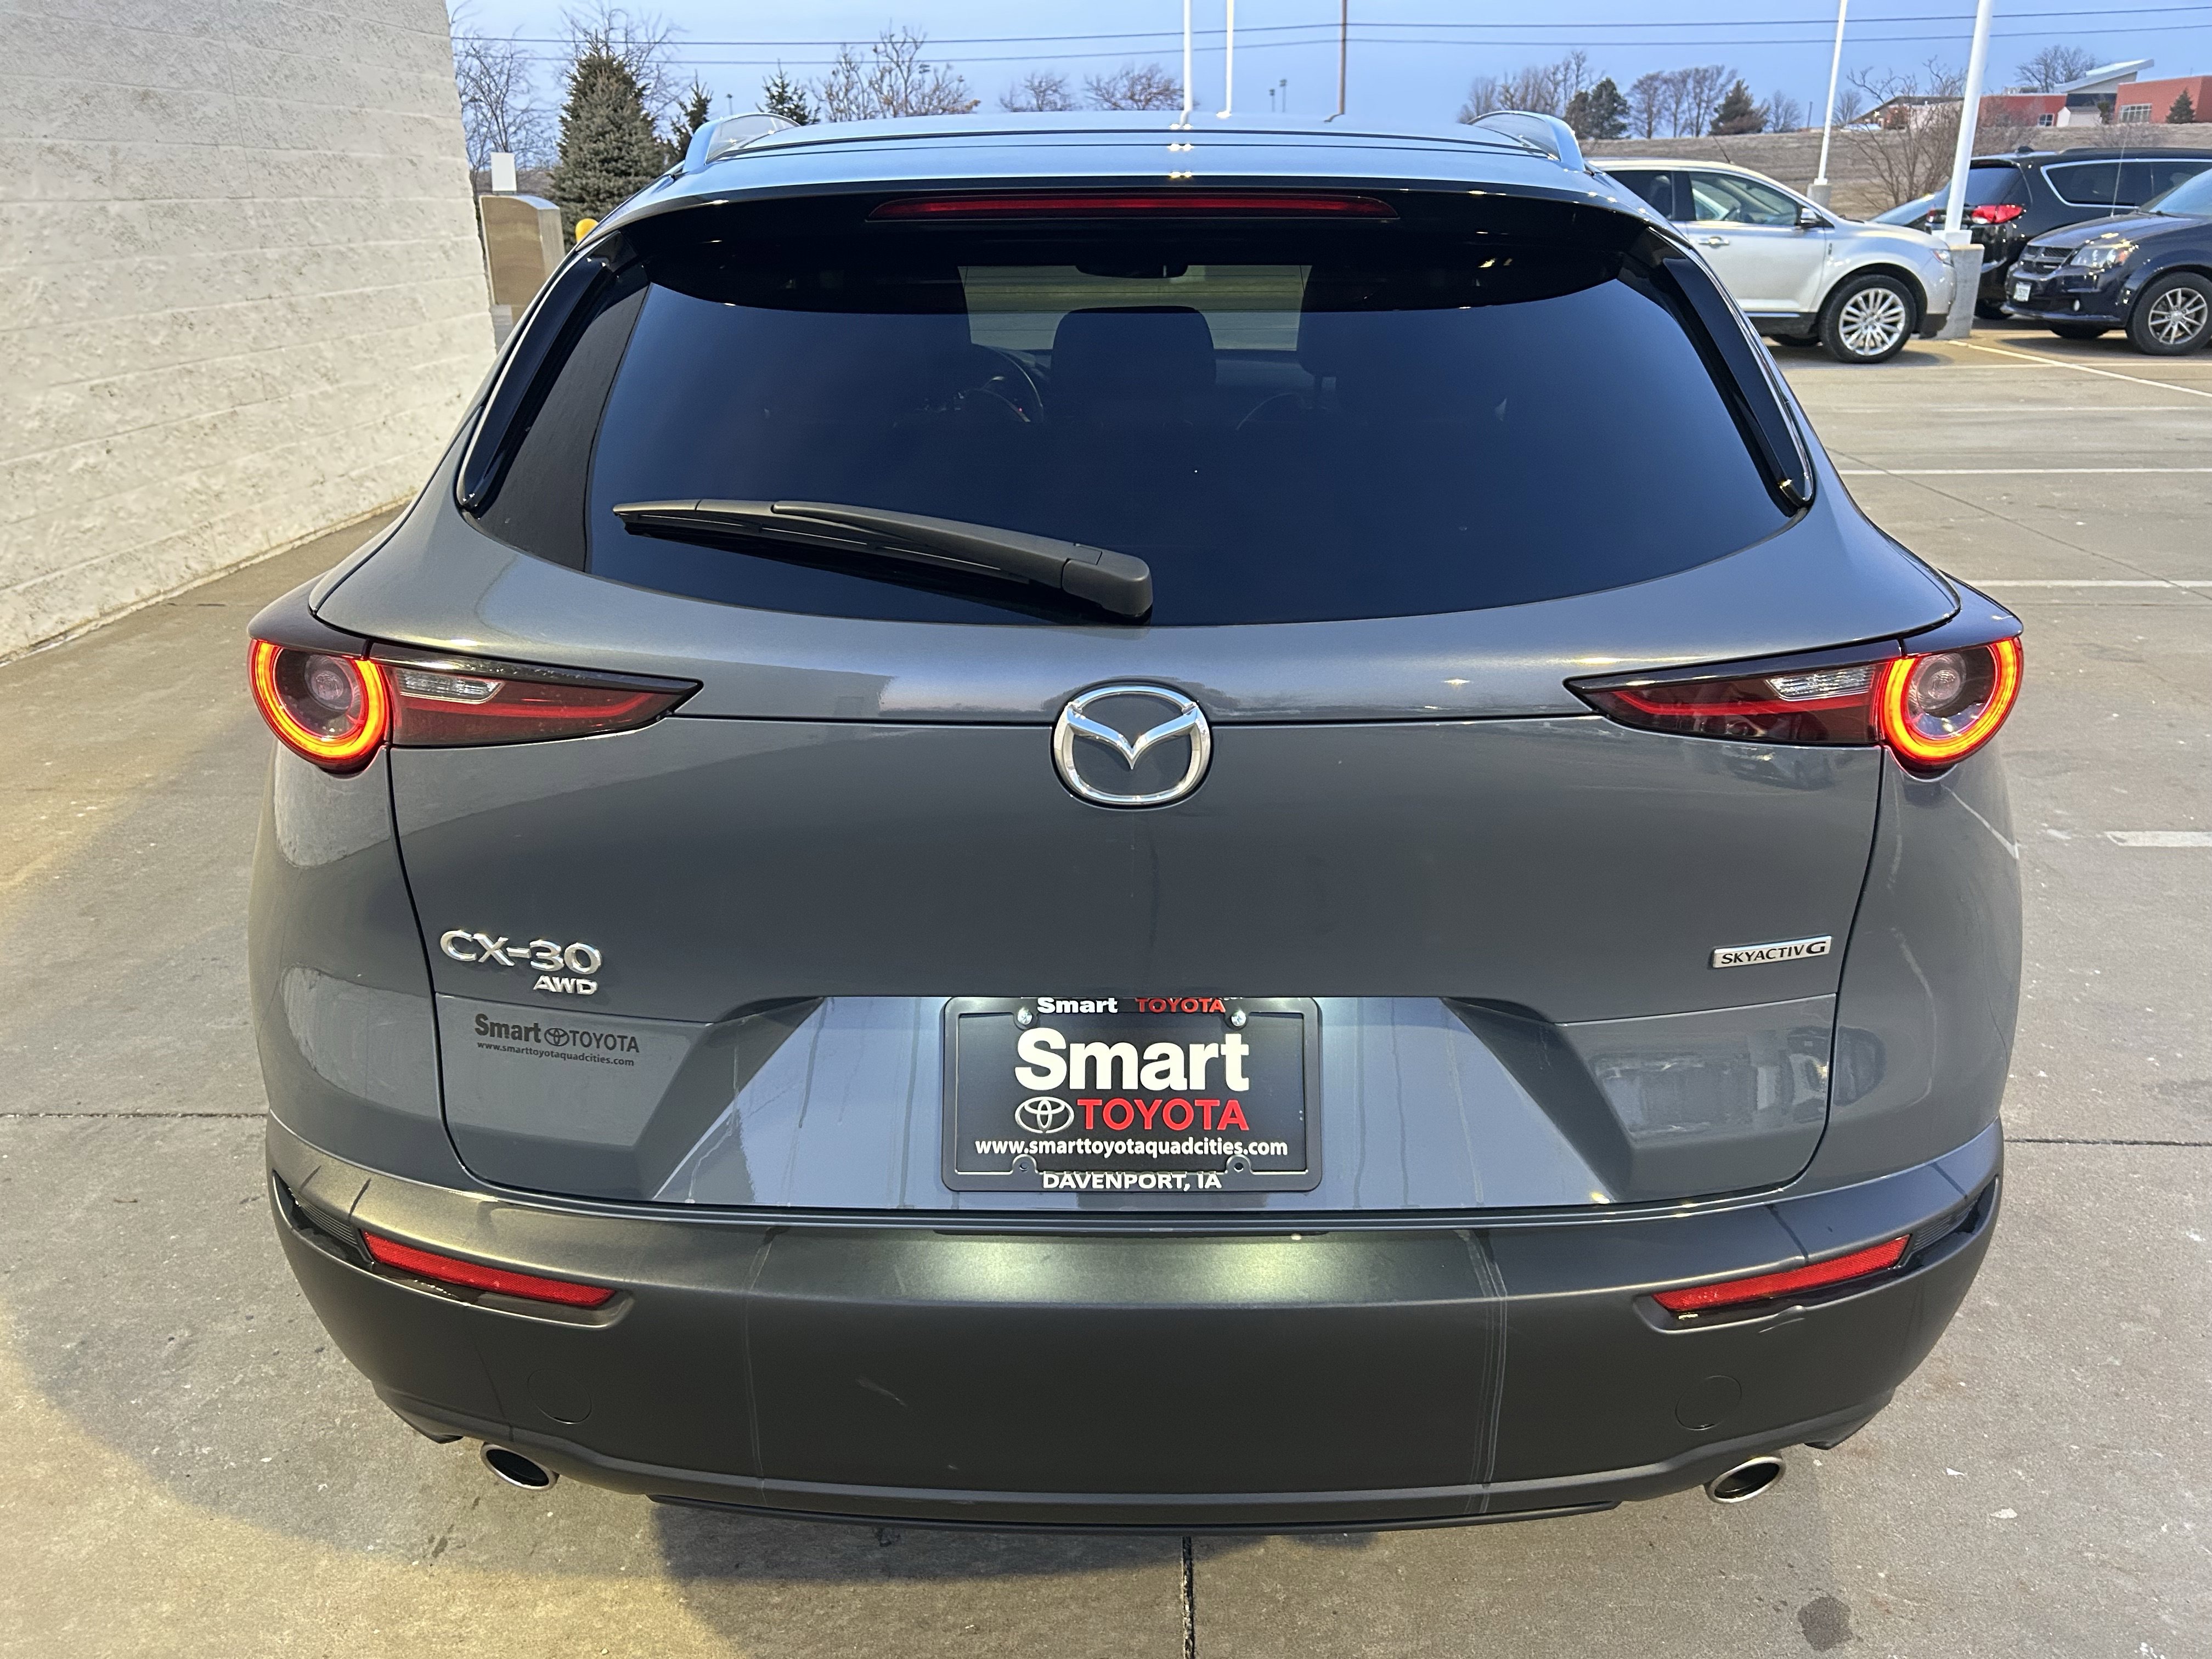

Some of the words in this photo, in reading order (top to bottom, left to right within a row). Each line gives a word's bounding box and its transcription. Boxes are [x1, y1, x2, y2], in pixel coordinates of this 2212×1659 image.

[440, 930, 602, 975] CX-30
[533, 975, 598, 995] AWD
[1037, 997, 1118, 1013] Smart
[1135, 998, 1226, 1013] TOYOTA
[475, 1013, 541, 1043] Smart
[570, 1031, 640, 1053] TOYOTA
[477, 1042, 634, 1066] www.smarttoyotaquadcities.com
[1015, 1027, 1249, 1092] Smart
[1077, 1098, 1249, 1131] TOYOTA
[975, 1137, 1288, 1158] www.smarttoyotaquadcities.com
[1043, 1173, 1191, 1190] DAVENPORT,
[1198, 1173, 1222, 1189] IA
